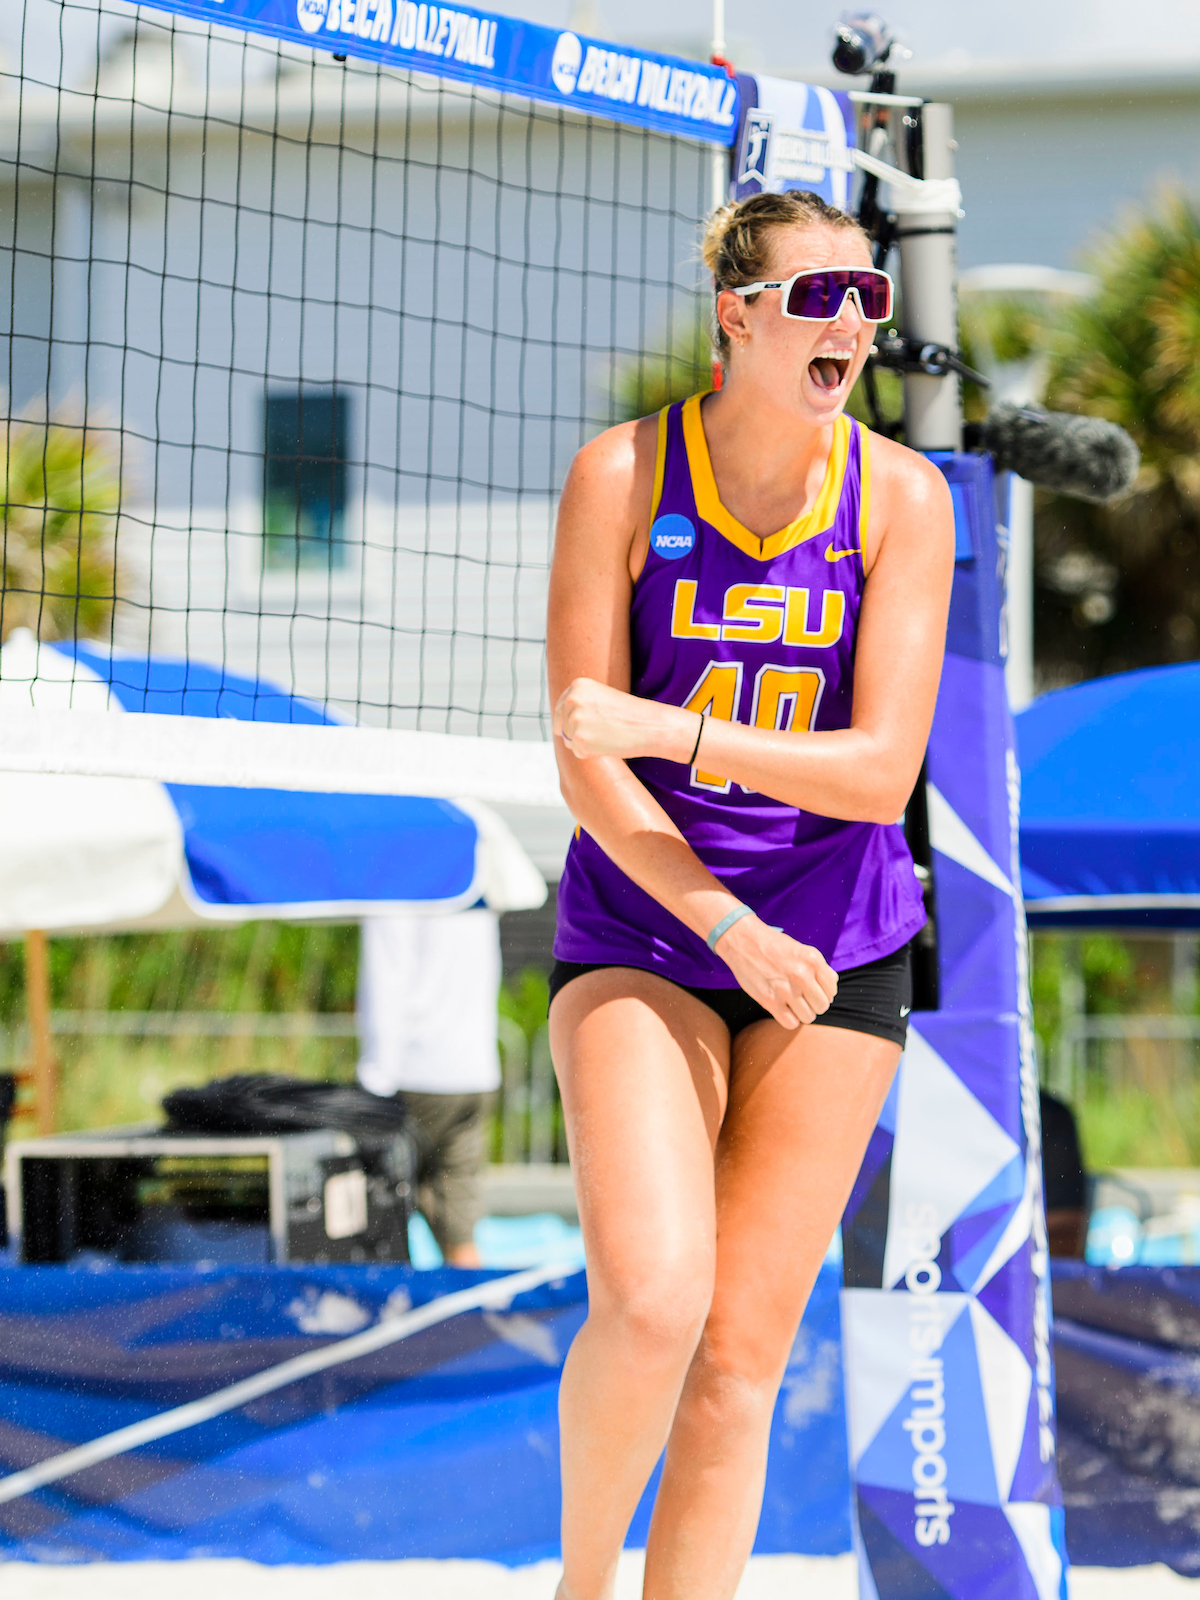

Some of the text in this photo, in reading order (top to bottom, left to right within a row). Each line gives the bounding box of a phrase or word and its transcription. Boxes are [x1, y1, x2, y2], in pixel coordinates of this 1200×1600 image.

[655, 534, 693, 548] NCAA
[671, 578, 846, 649] LSU
[680, 659, 827, 795] 40
